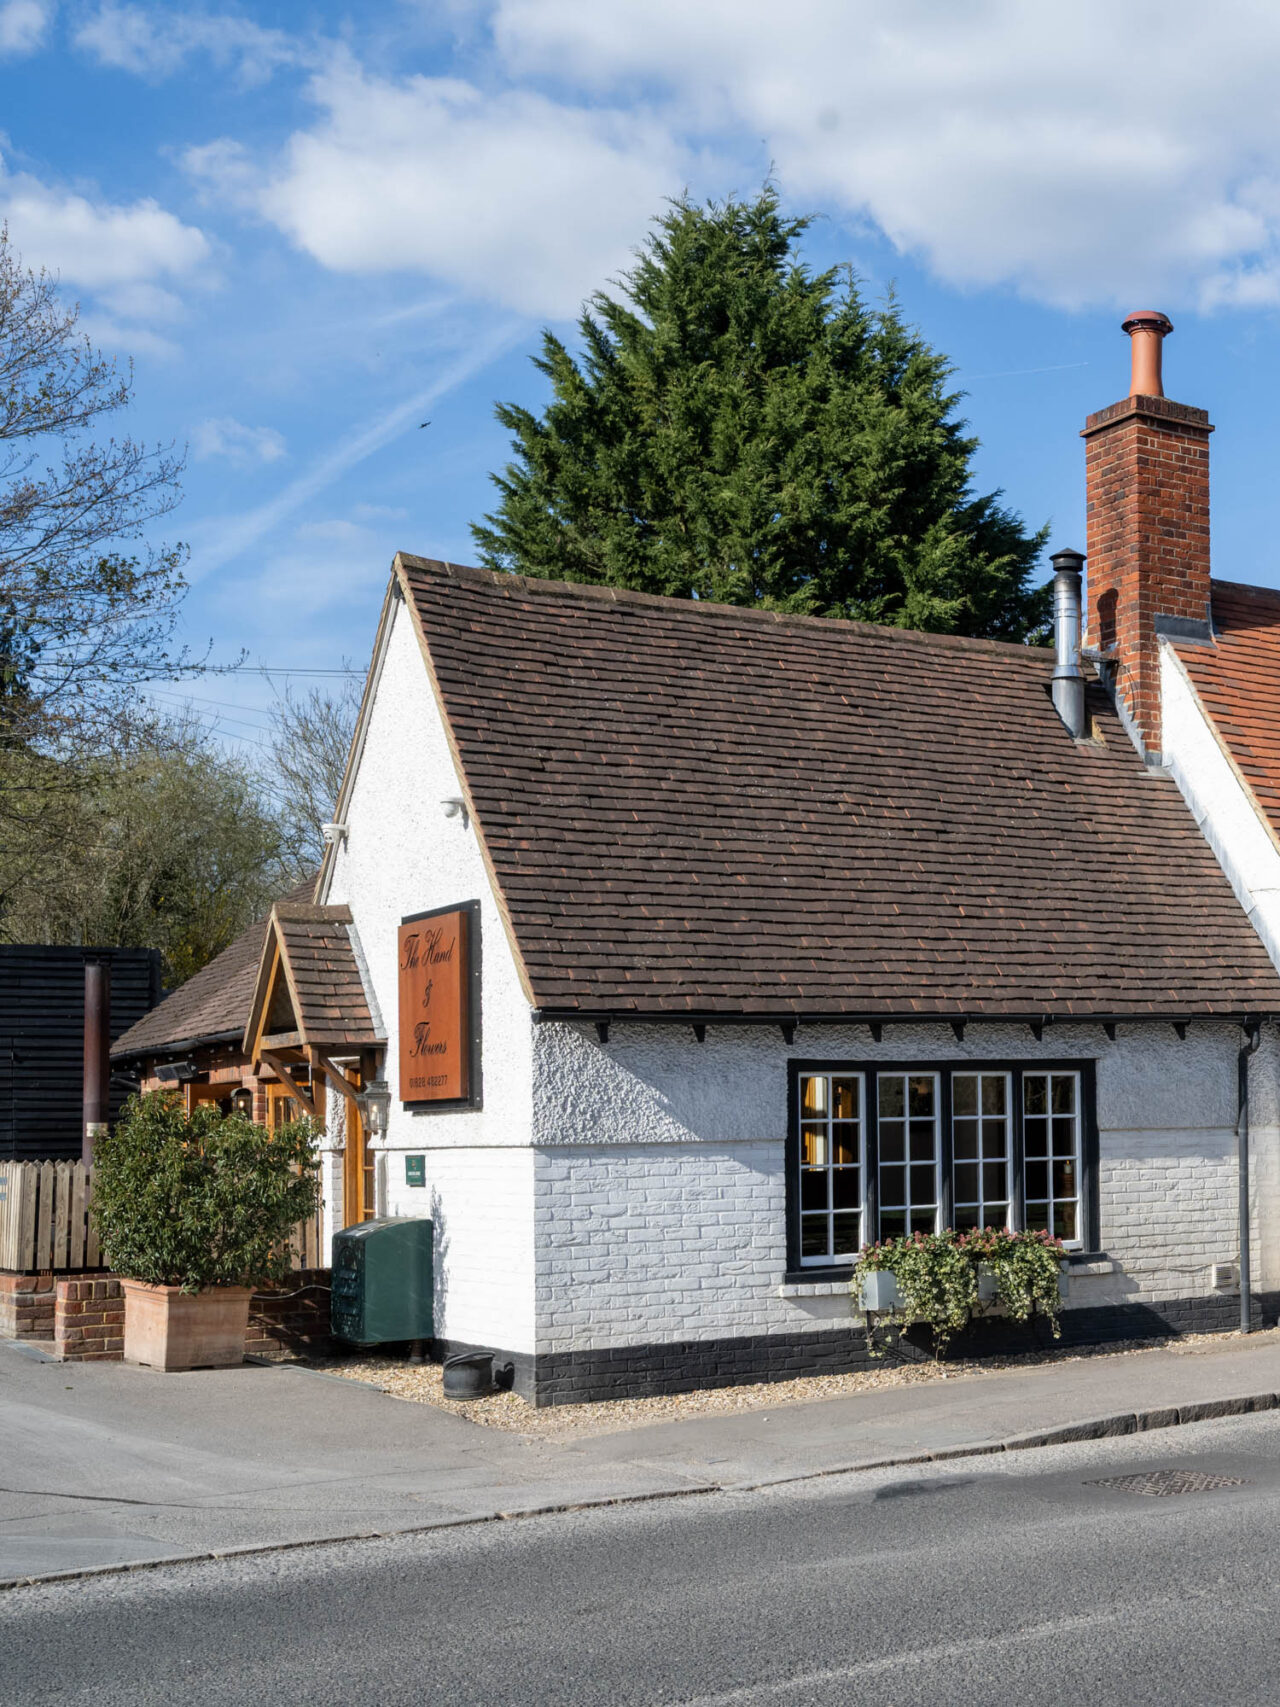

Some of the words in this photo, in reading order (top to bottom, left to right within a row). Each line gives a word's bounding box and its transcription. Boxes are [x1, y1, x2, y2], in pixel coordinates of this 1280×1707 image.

[400, 933, 420, 970] The
[421, 927, 456, 967] Hand
[422, 978, 433, 1008] &
[409, 1021, 447, 1058] Flowers
